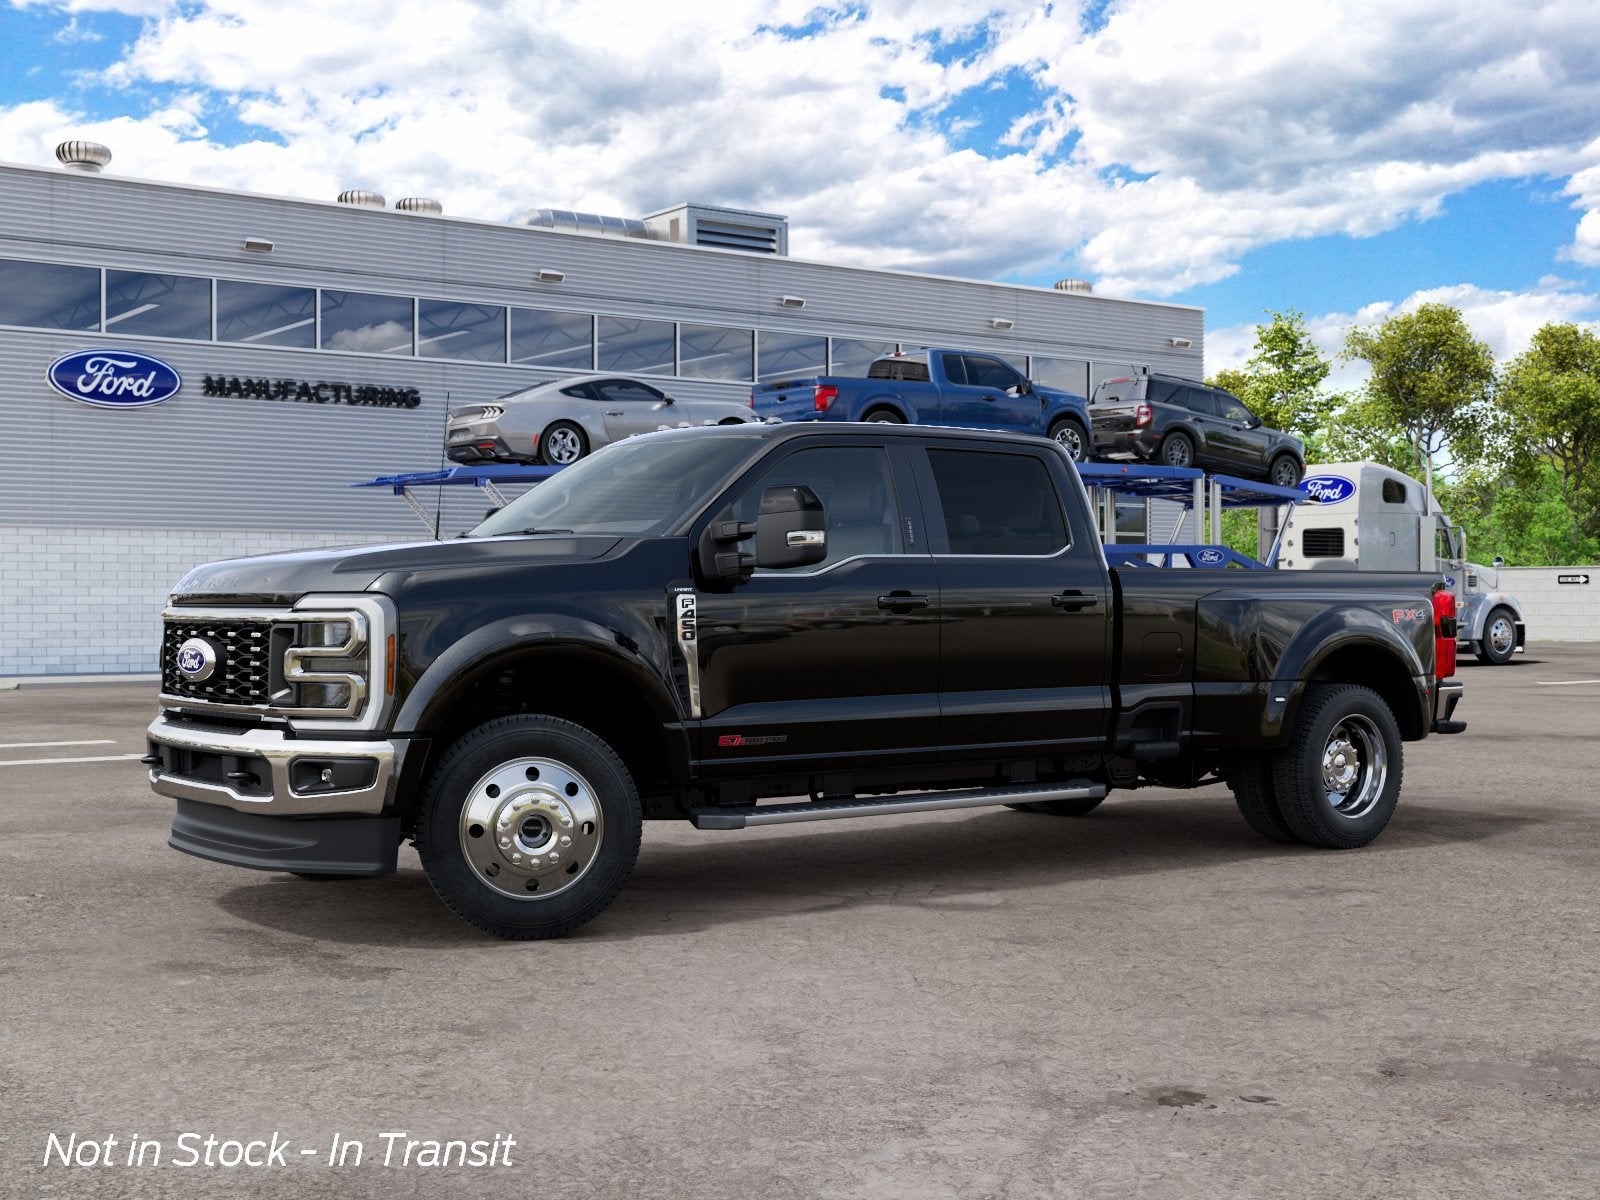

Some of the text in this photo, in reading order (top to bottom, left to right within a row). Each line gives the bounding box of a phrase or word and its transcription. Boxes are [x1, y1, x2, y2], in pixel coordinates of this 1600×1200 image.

[77, 357, 421, 409] Ford MANUFACTURING
[1307, 480, 1343, 500] Ford
[1392, 609, 1427, 623] FX4
[181, 649, 201, 670] Ford
